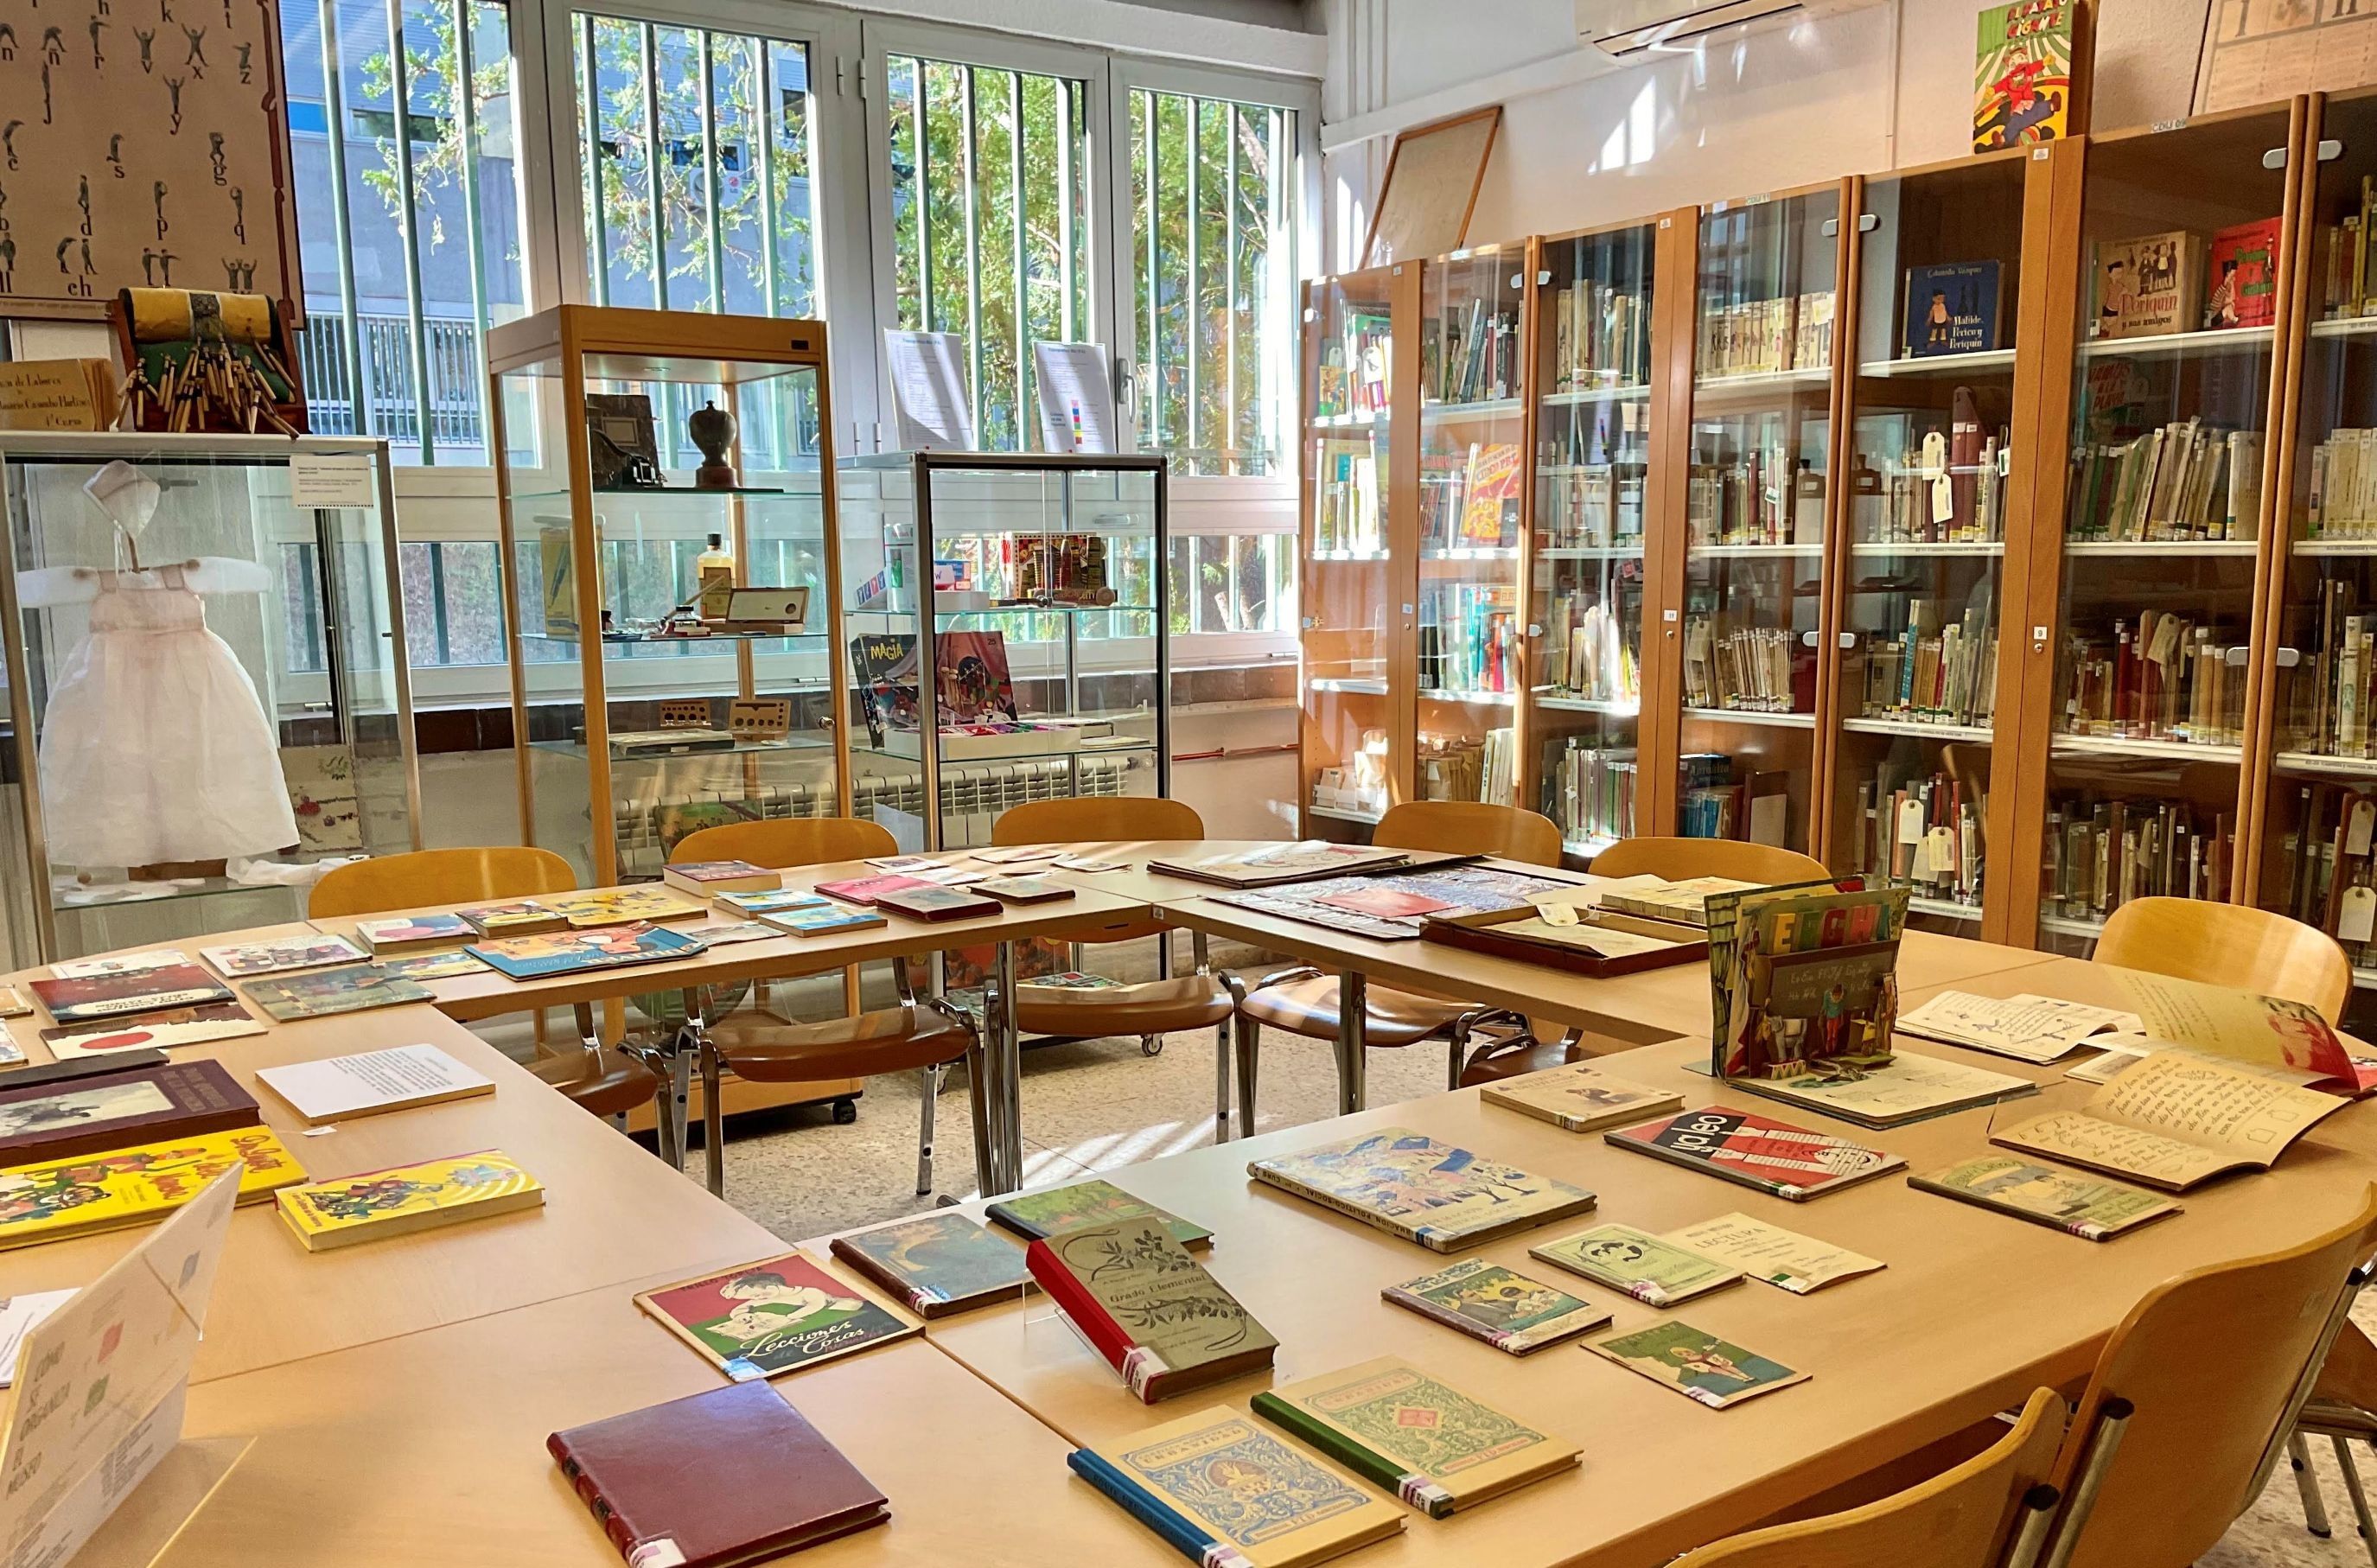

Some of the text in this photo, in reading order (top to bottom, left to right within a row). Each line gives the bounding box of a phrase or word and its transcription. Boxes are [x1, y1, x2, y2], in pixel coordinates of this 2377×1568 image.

[2007, 11, 2065, 39] GIGANTE
[2, 47, 14, 61] n
[94, 55, 105, 69] r
[192, 66, 204, 80] x
[240, 72, 252, 84] z
[169, 113, 182, 135] y
[114, 165, 125, 179] s
[213, 165, 227, 186] g
[80, 215, 92, 236] d
[156, 218, 169, 240] p
[233, 222, 246, 245] q
[67, 274, 92, 297] ch
[2143, 315, 2172, 328] amigos
[870, 641, 904, 660] MAGIA
[1670, 1115, 1728, 1153] ya leo
[1694, 1227, 1768, 1248] LECTURA
[1110, 1290, 1145, 1303] Grado
[1149, 1273, 1207, 1293] Elemental
[739, 1318, 852, 1359] Lecciones
[800, 1327, 865, 1354] Cosas
[1141, 1427, 1243, 1464] URBANIDAD
